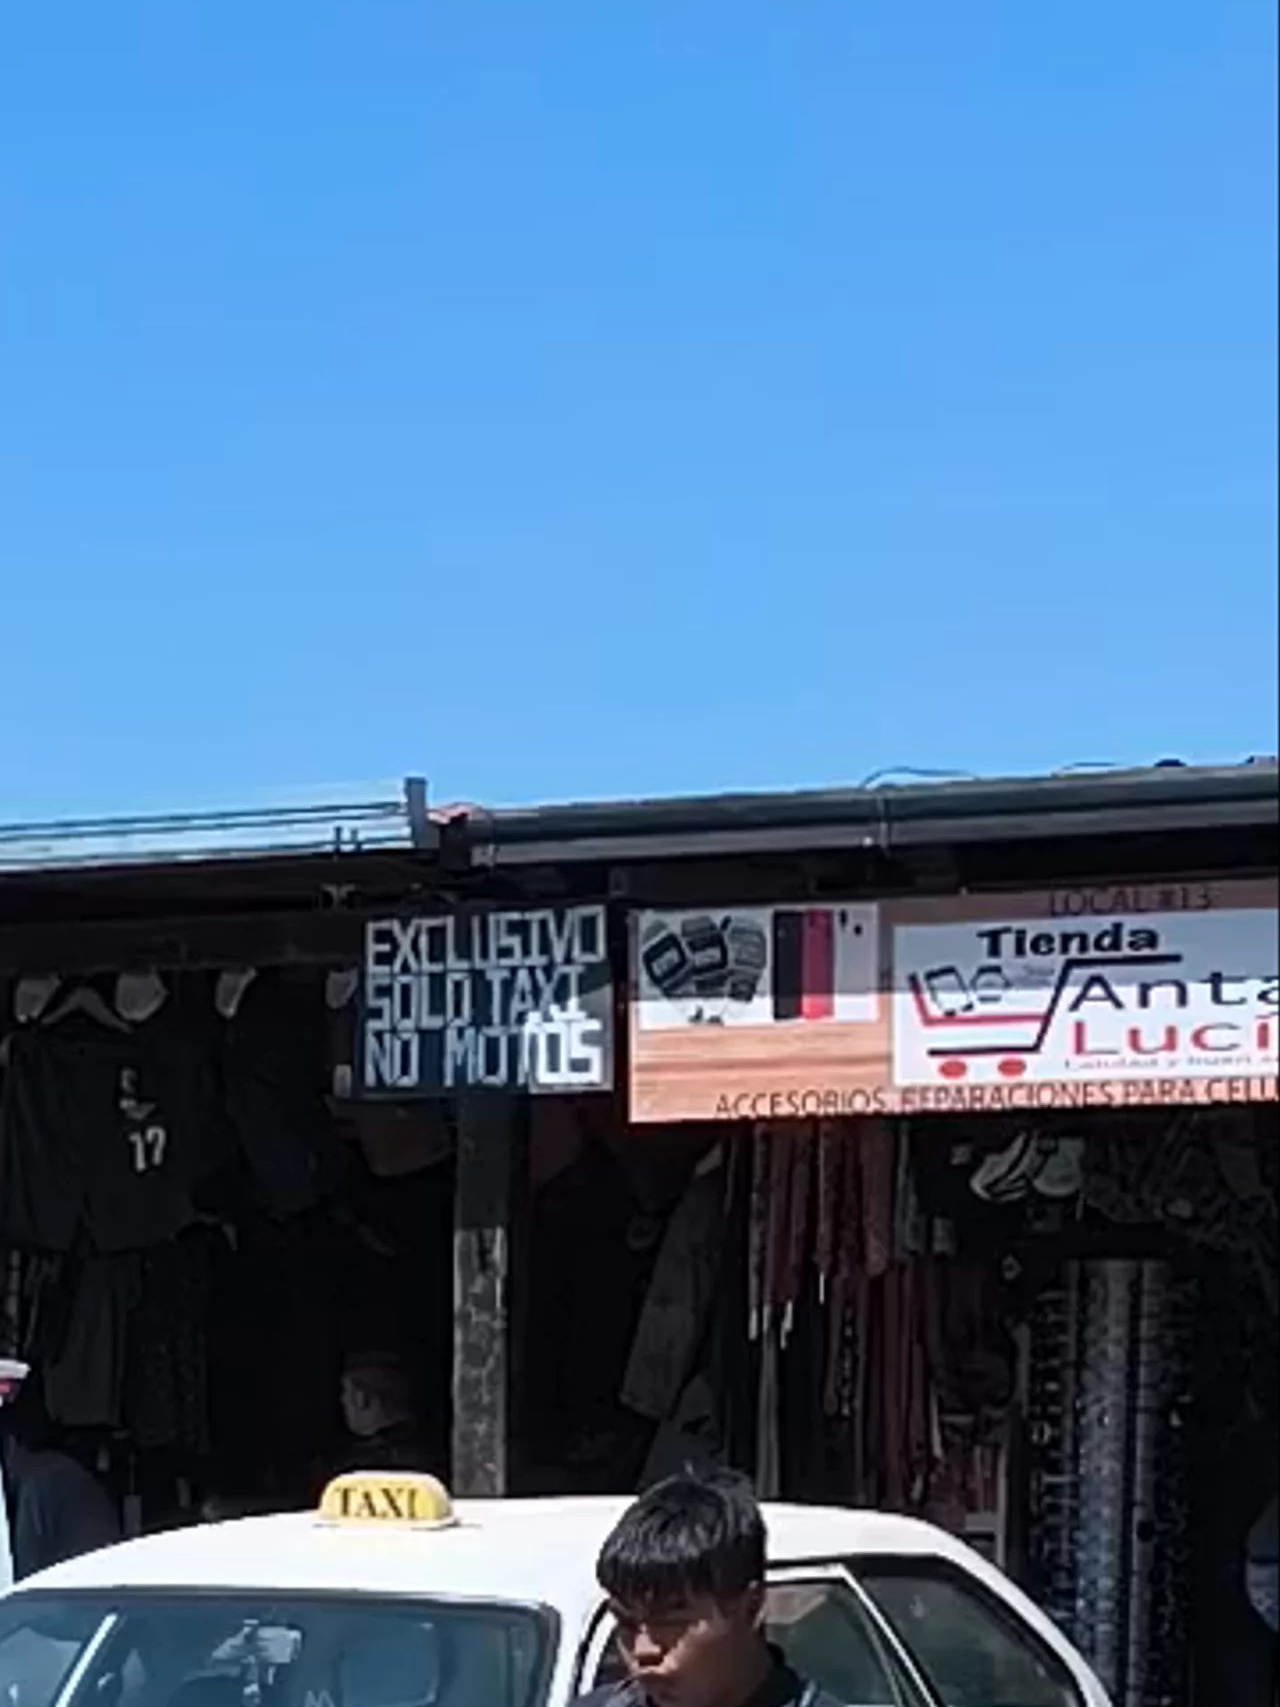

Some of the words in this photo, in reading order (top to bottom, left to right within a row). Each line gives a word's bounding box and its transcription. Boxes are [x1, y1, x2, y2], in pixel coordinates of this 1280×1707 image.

[1050, 888, 1147, 917] LOCAL
[365, 905, 607, 975] EXCLUSIVO
[975, 922, 1160, 958] Tienda
[365, 971, 472, 1031] SOLO
[485, 964, 587, 1030] TAXI
[364, 1030, 419, 1087] NO
[443, 1019, 603, 1087] MOTOS
[1123, 1078, 1196, 1104] PARA
[332, 1486, 419, 1520] TAXI
